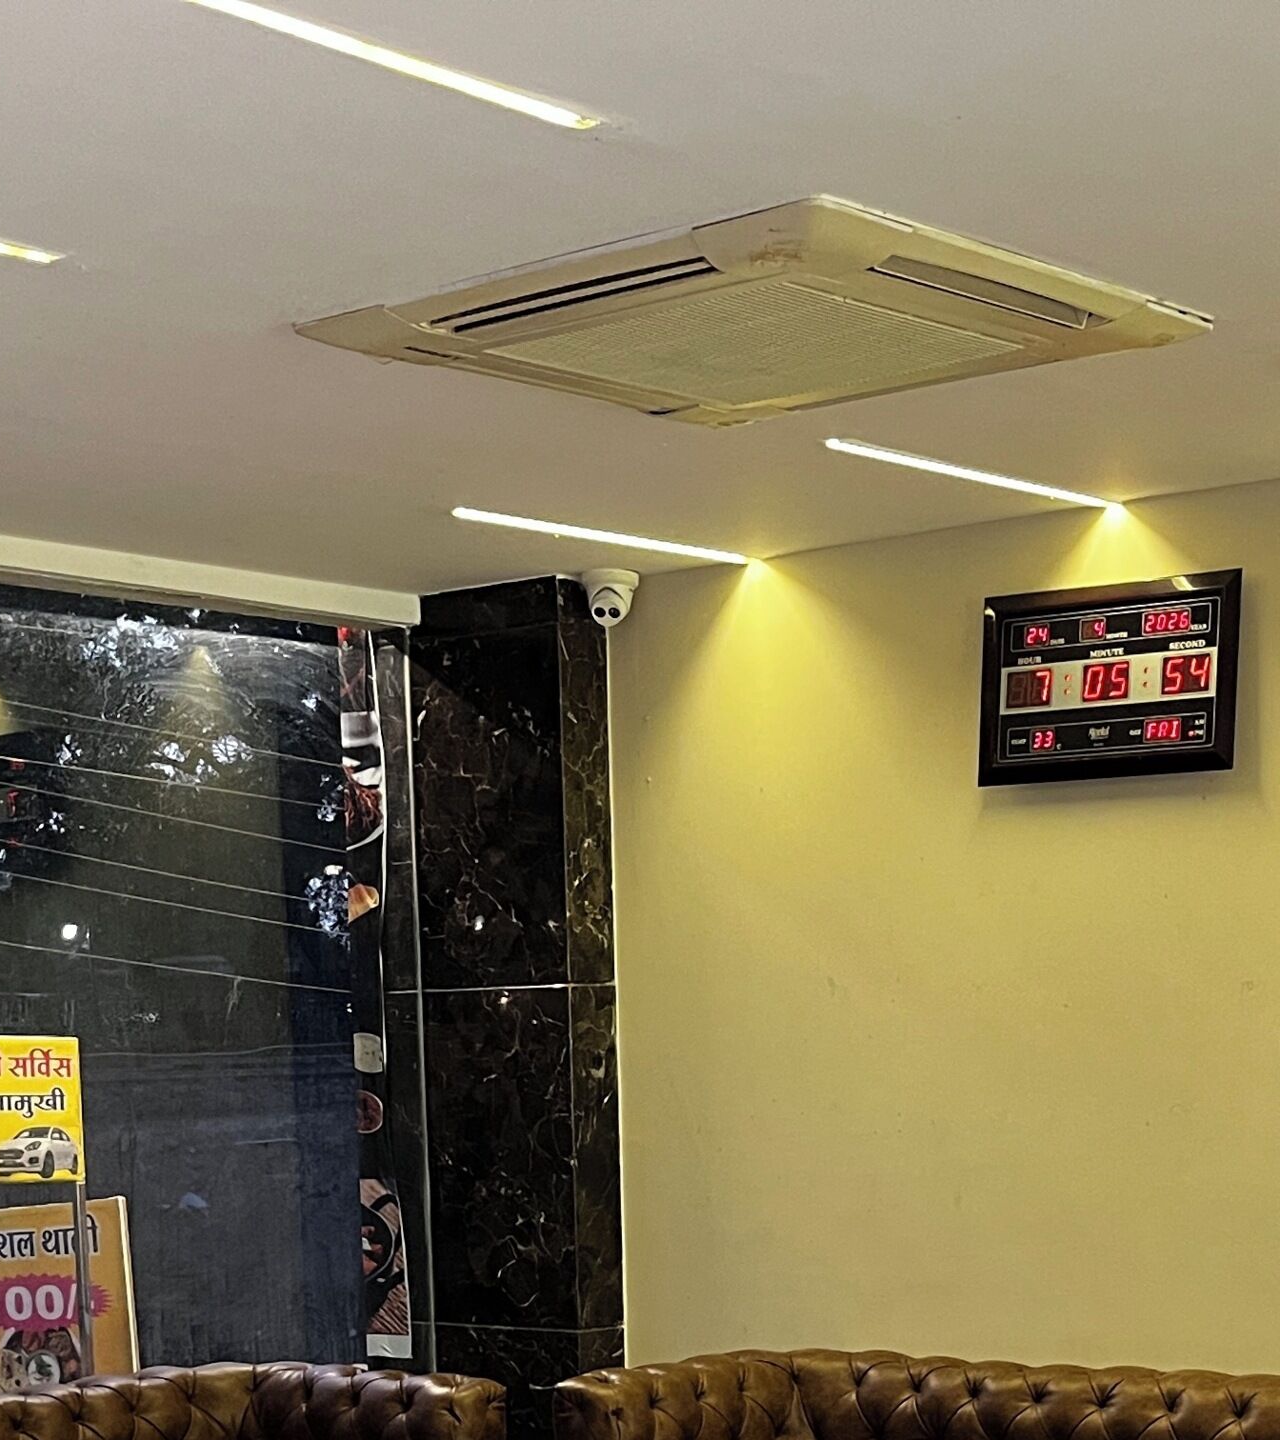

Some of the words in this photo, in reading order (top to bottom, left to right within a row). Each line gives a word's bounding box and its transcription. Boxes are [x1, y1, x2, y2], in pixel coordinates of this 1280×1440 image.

[1094, 621, 1105, 636] 4
[1145, 611, 1189, 632] 2026
[1026, 627, 1048, 644] 24
[1089, 647, 1125, 659] MINUTE
[1168, 639, 1207, 650] SECOND
[1017, 656, 1042, 665] HOUR
[1082, 664, 1129, 699] 05
[1163, 655, 1211, 693] 54
[1032, 730, 1054, 749] 33
[9, 1048, 72, 1078] सर्विस
